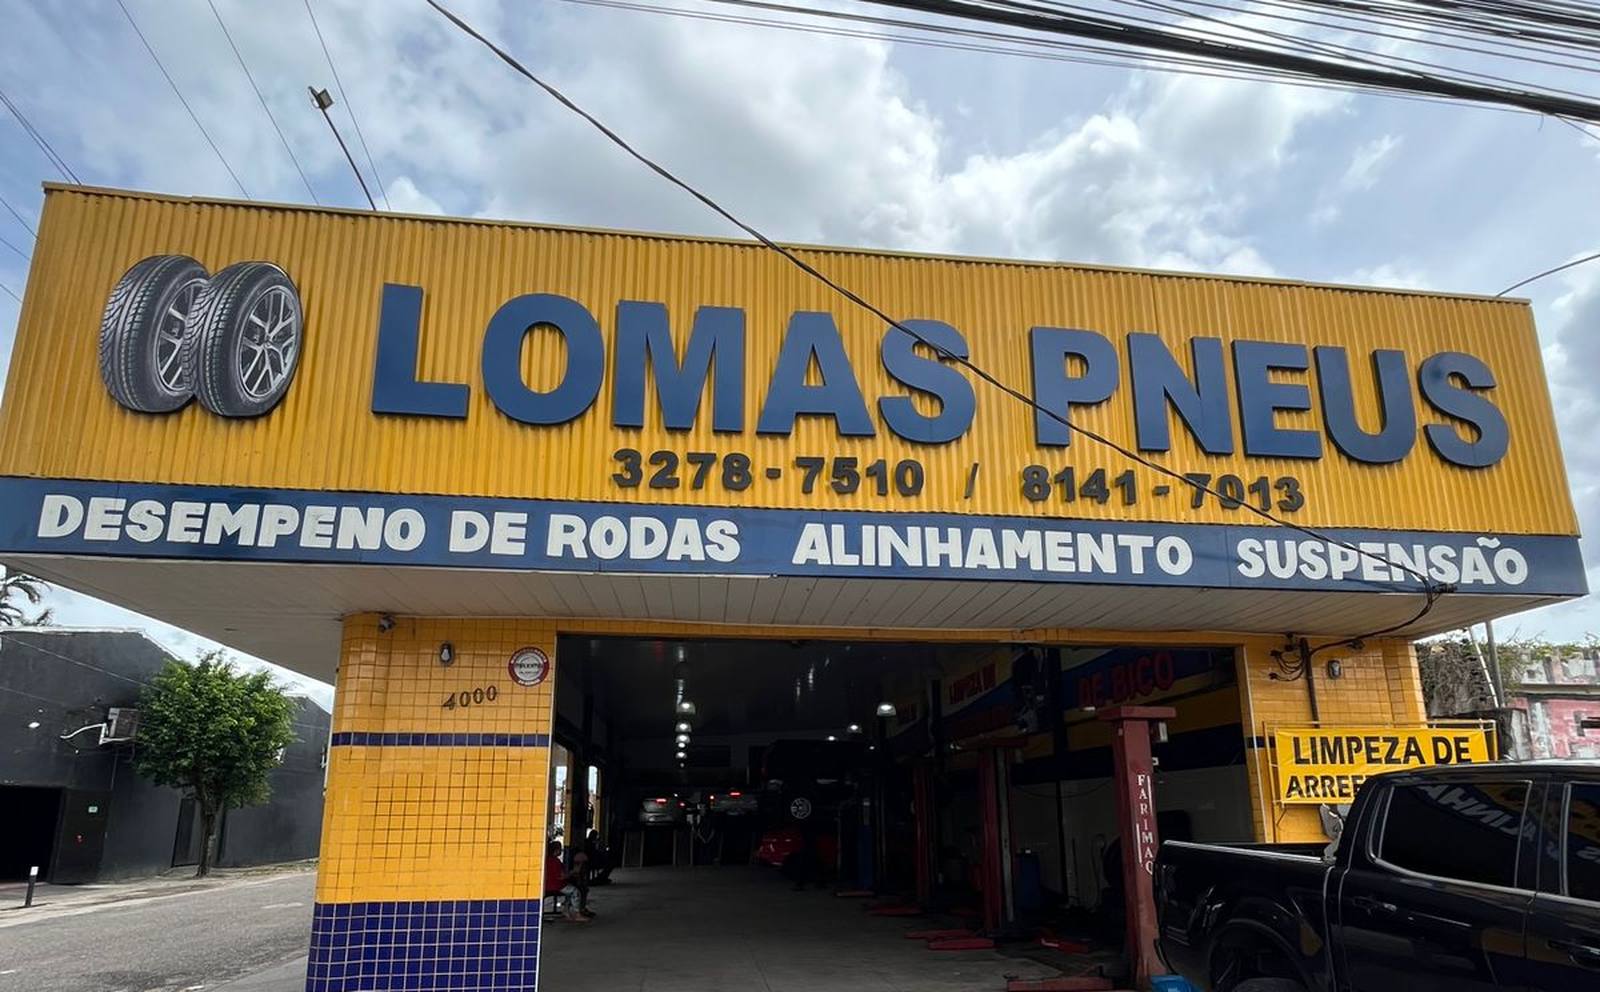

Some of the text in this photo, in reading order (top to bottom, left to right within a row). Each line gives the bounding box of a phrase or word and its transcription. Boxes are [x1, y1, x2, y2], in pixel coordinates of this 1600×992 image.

[371, 282, 1509, 469] LOMAS PNEUS
[964, 462, 979, 499] /
[37, 494, 1529, 586] DESEMPENO DE RODAS ALINHAMENTO SUSPENSÃO
[1111, 650, 1175, 704] BICO
[442, 684, 499, 711] 4000
[1293, 736, 1472, 764] LIMPEZA DE
[1286, 774, 1374, 798] ARREF
